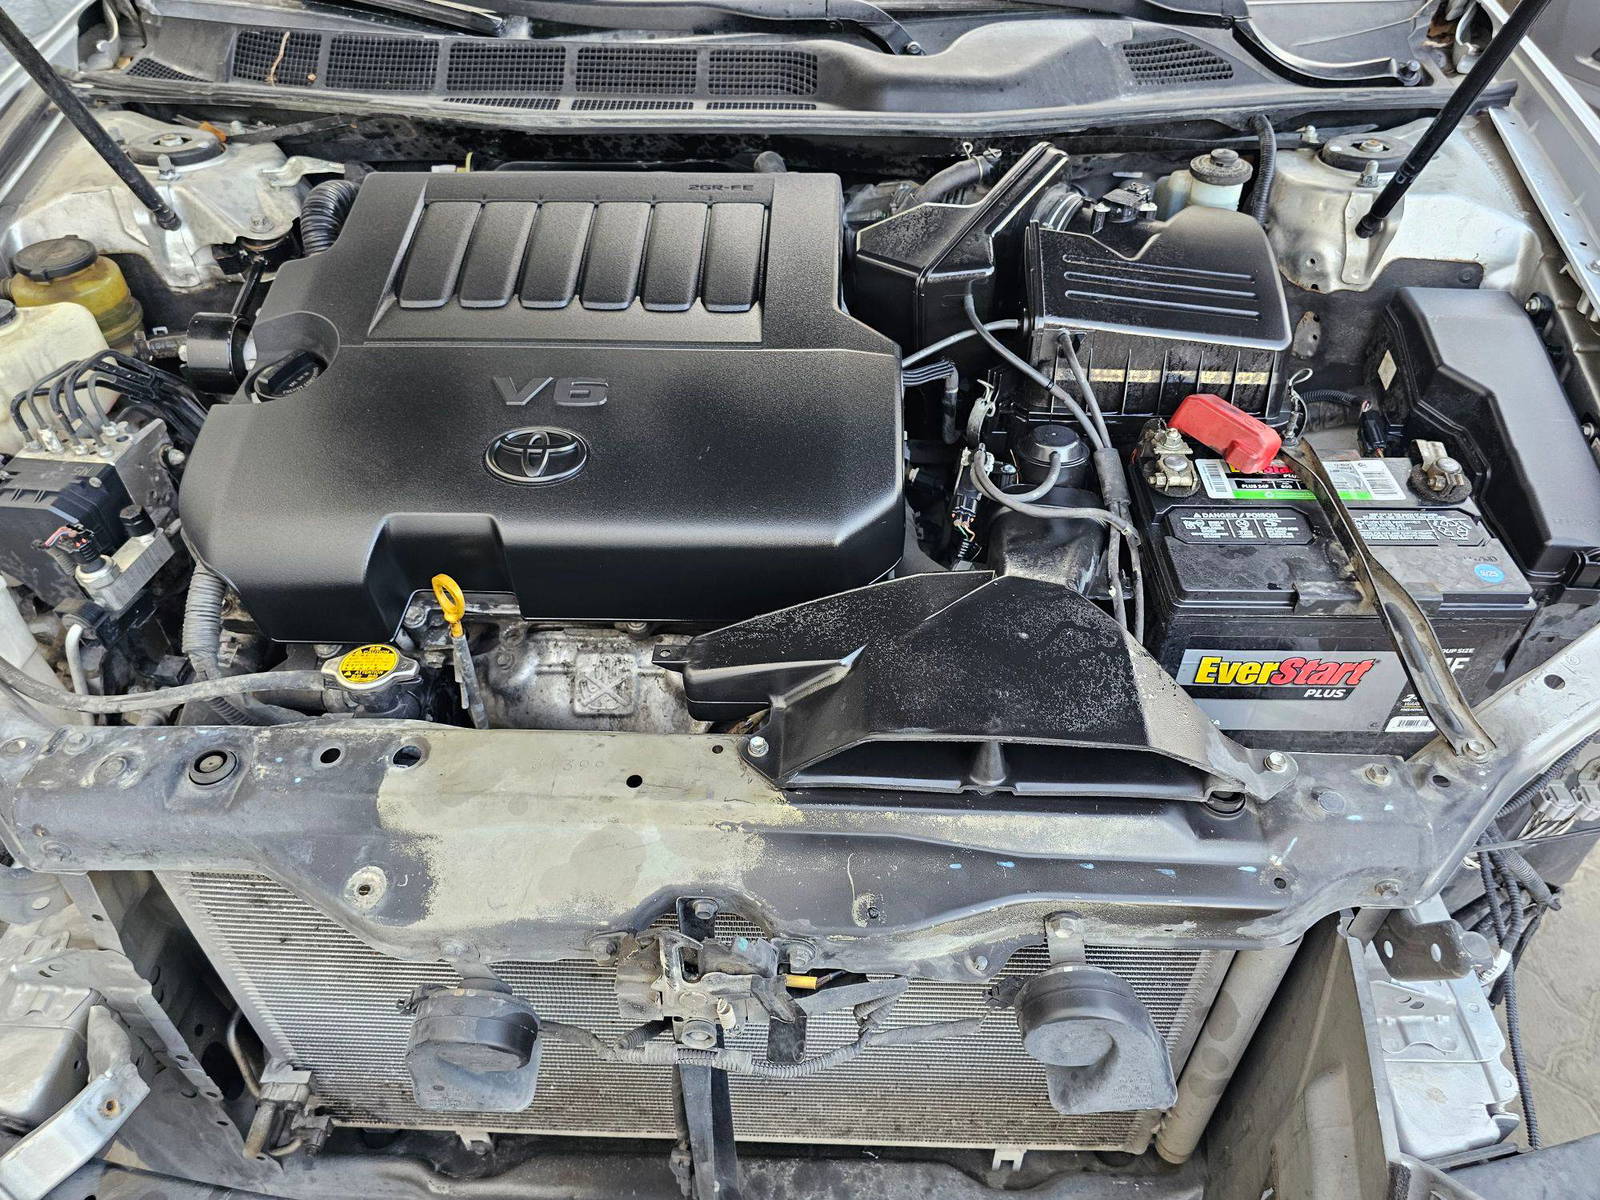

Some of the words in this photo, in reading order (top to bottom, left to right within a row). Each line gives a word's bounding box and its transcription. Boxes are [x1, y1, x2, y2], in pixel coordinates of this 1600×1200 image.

[493, 376, 609, 406] V6
[1194, 655, 1377, 686] EverStart
[1303, 688, 1347, 698] PLUS
